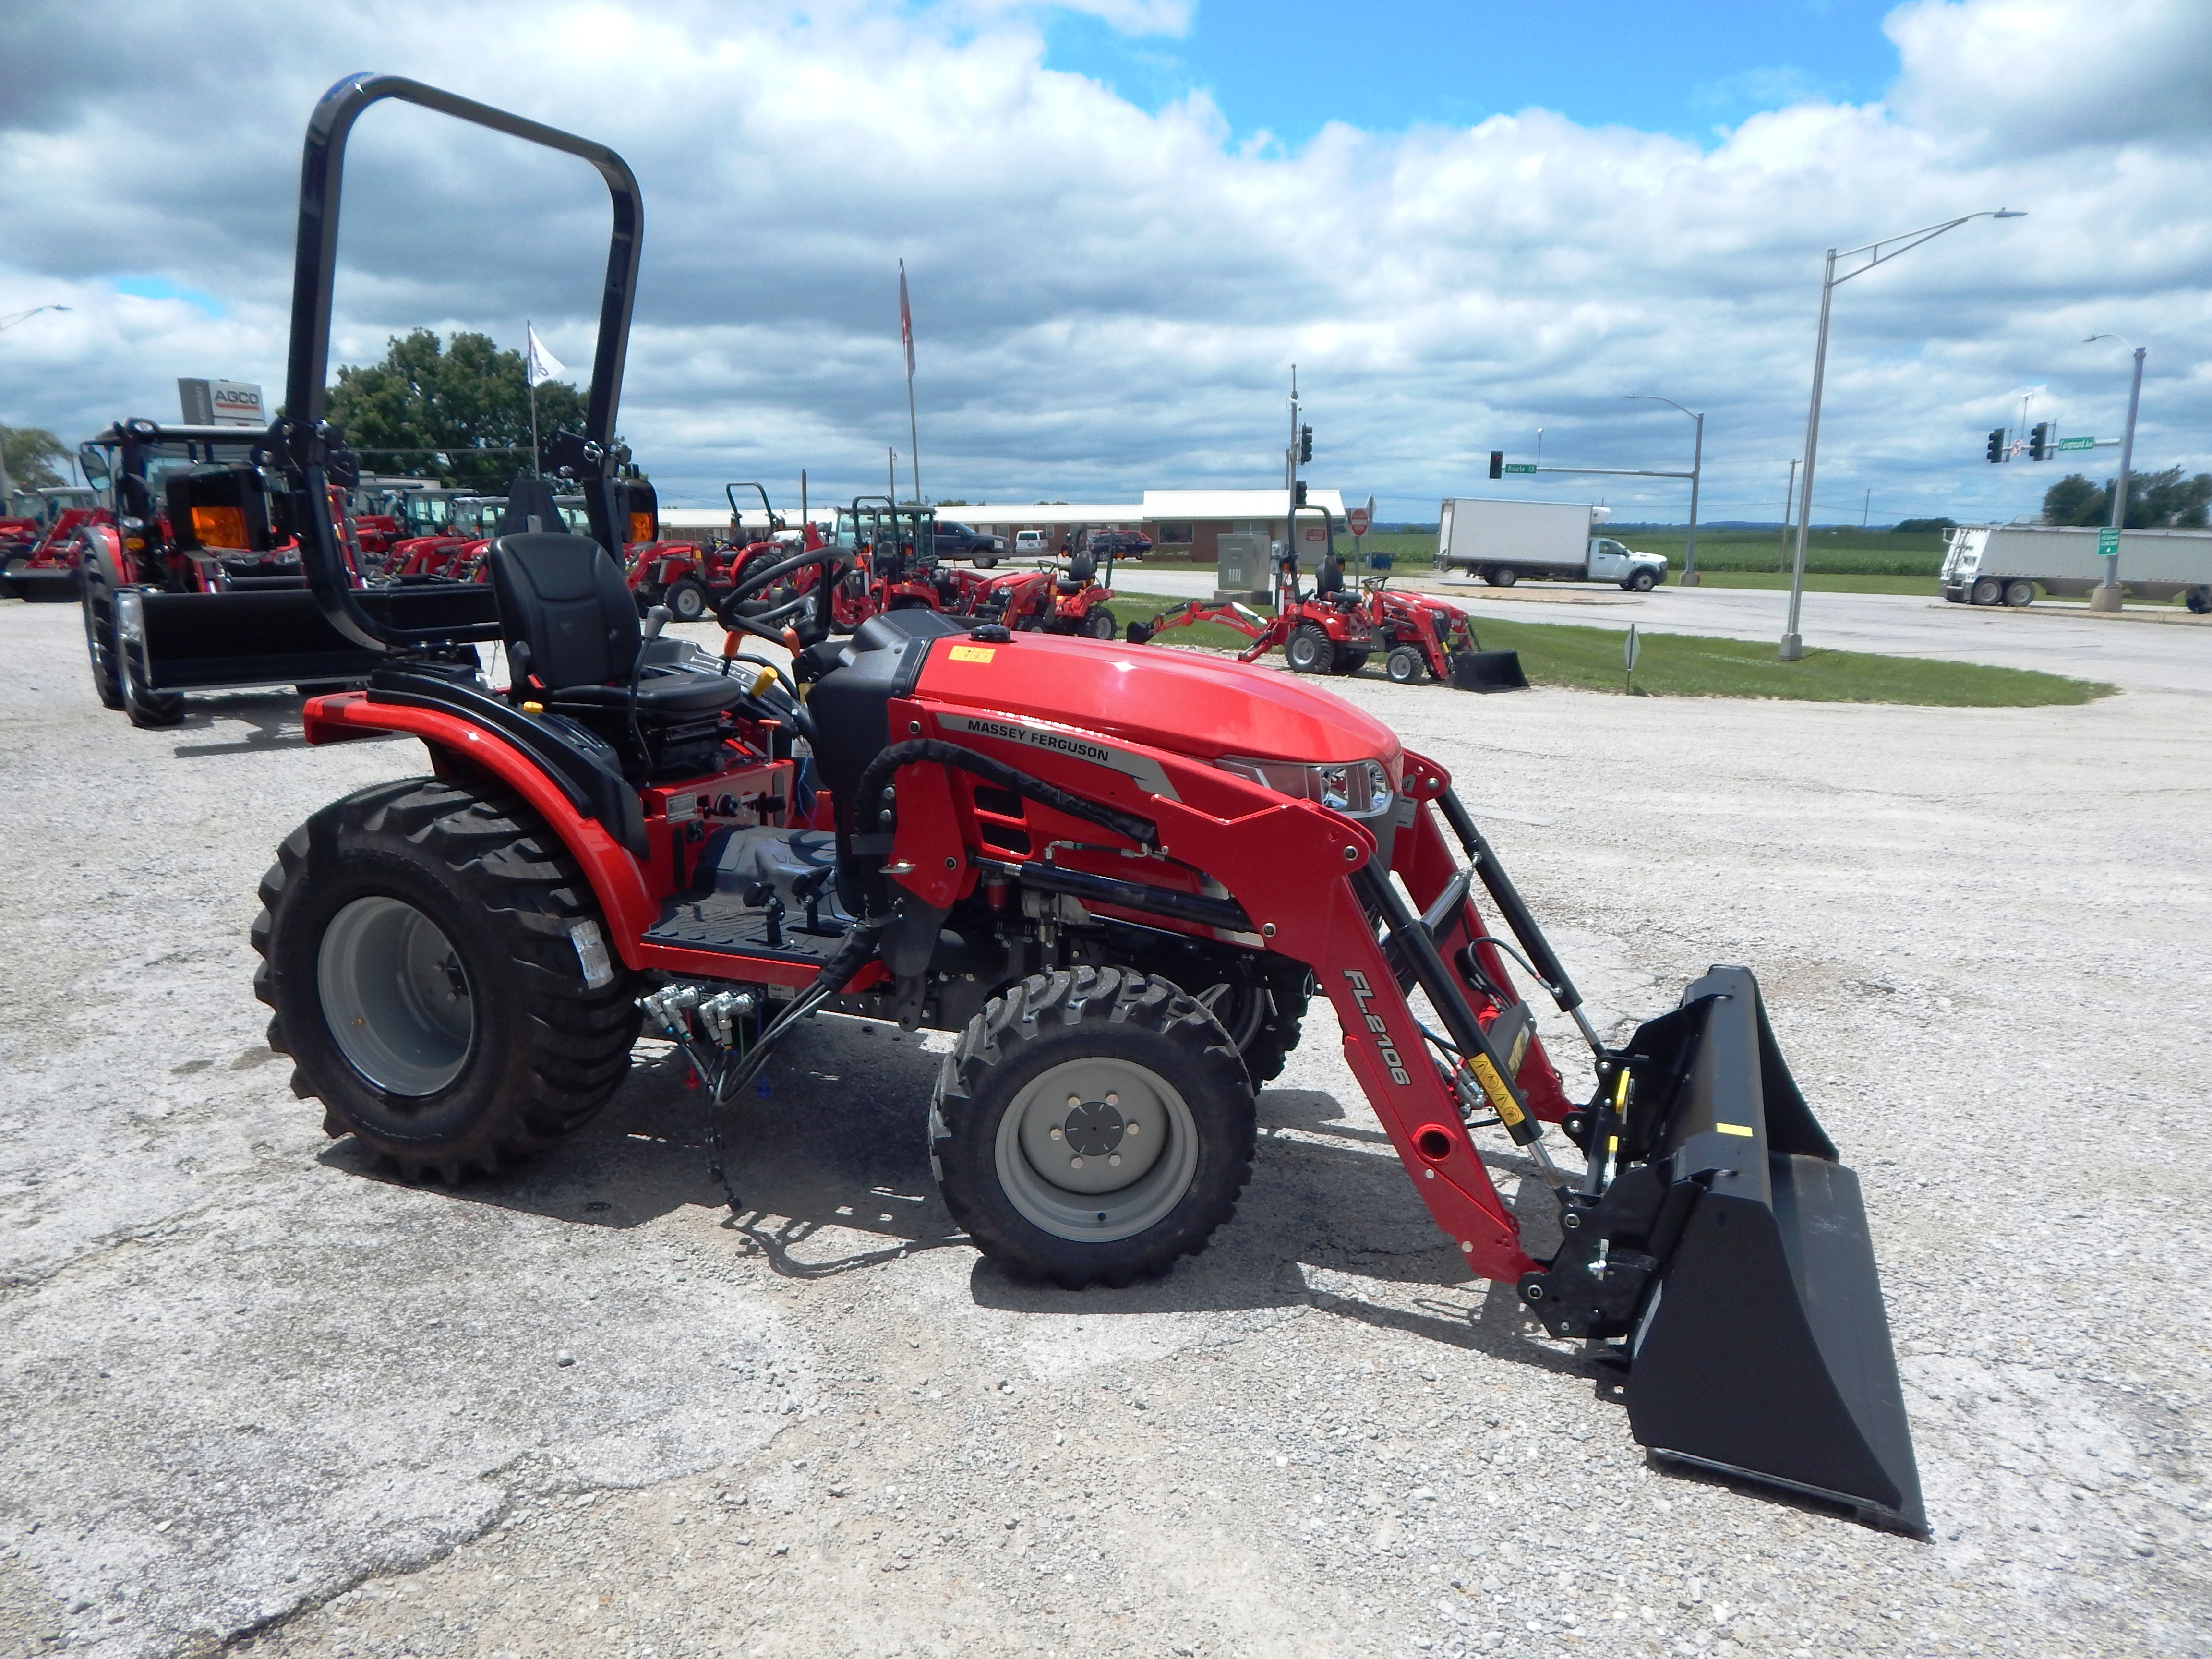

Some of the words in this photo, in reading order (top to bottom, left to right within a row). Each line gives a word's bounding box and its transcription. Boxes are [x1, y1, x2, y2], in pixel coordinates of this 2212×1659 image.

[215, 390, 259, 404] AGCO
[968, 720, 1026, 740] MASSEY
[1031, 733, 1109, 761] FERGUSON
[1343, 970, 1412, 1085] FL.2106
